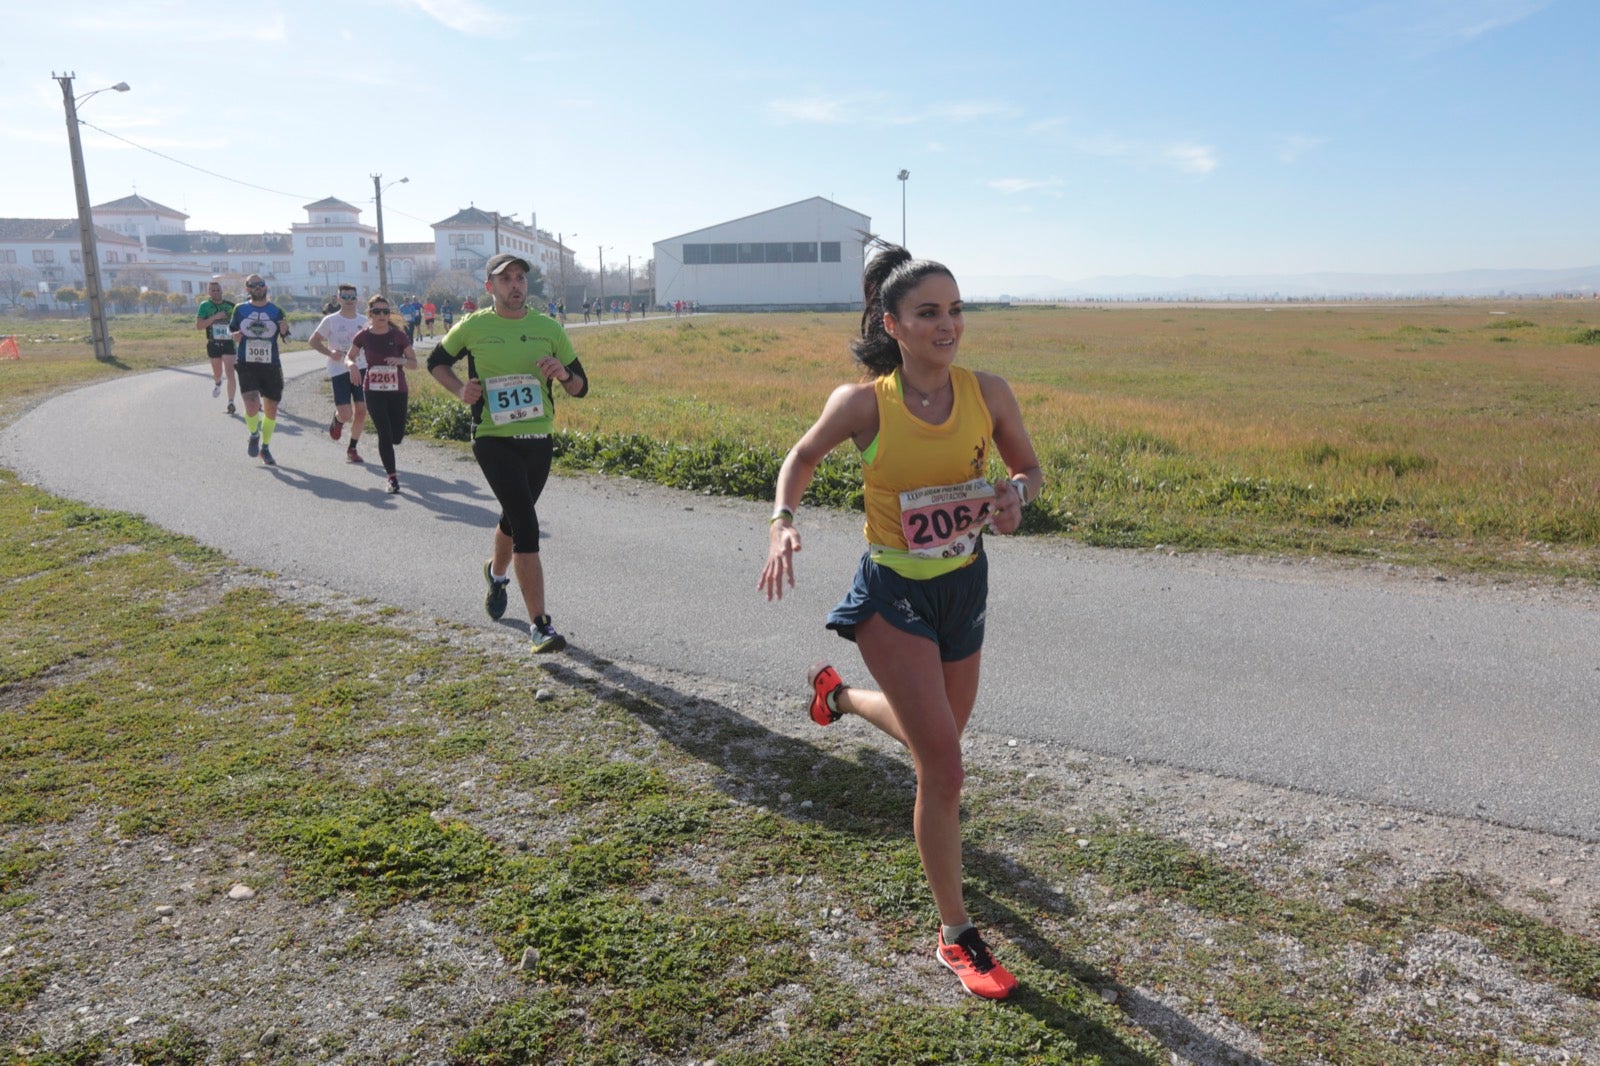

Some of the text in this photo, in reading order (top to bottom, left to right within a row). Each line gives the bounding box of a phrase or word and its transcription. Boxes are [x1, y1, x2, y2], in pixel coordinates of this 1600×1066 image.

[248, 347, 269, 356] 3081
[370, 373, 396, 384] 2261
[497, 387, 533, 409] 513
[942, 484, 964, 493] PREMIO
[965, 483, 973, 491] DE
